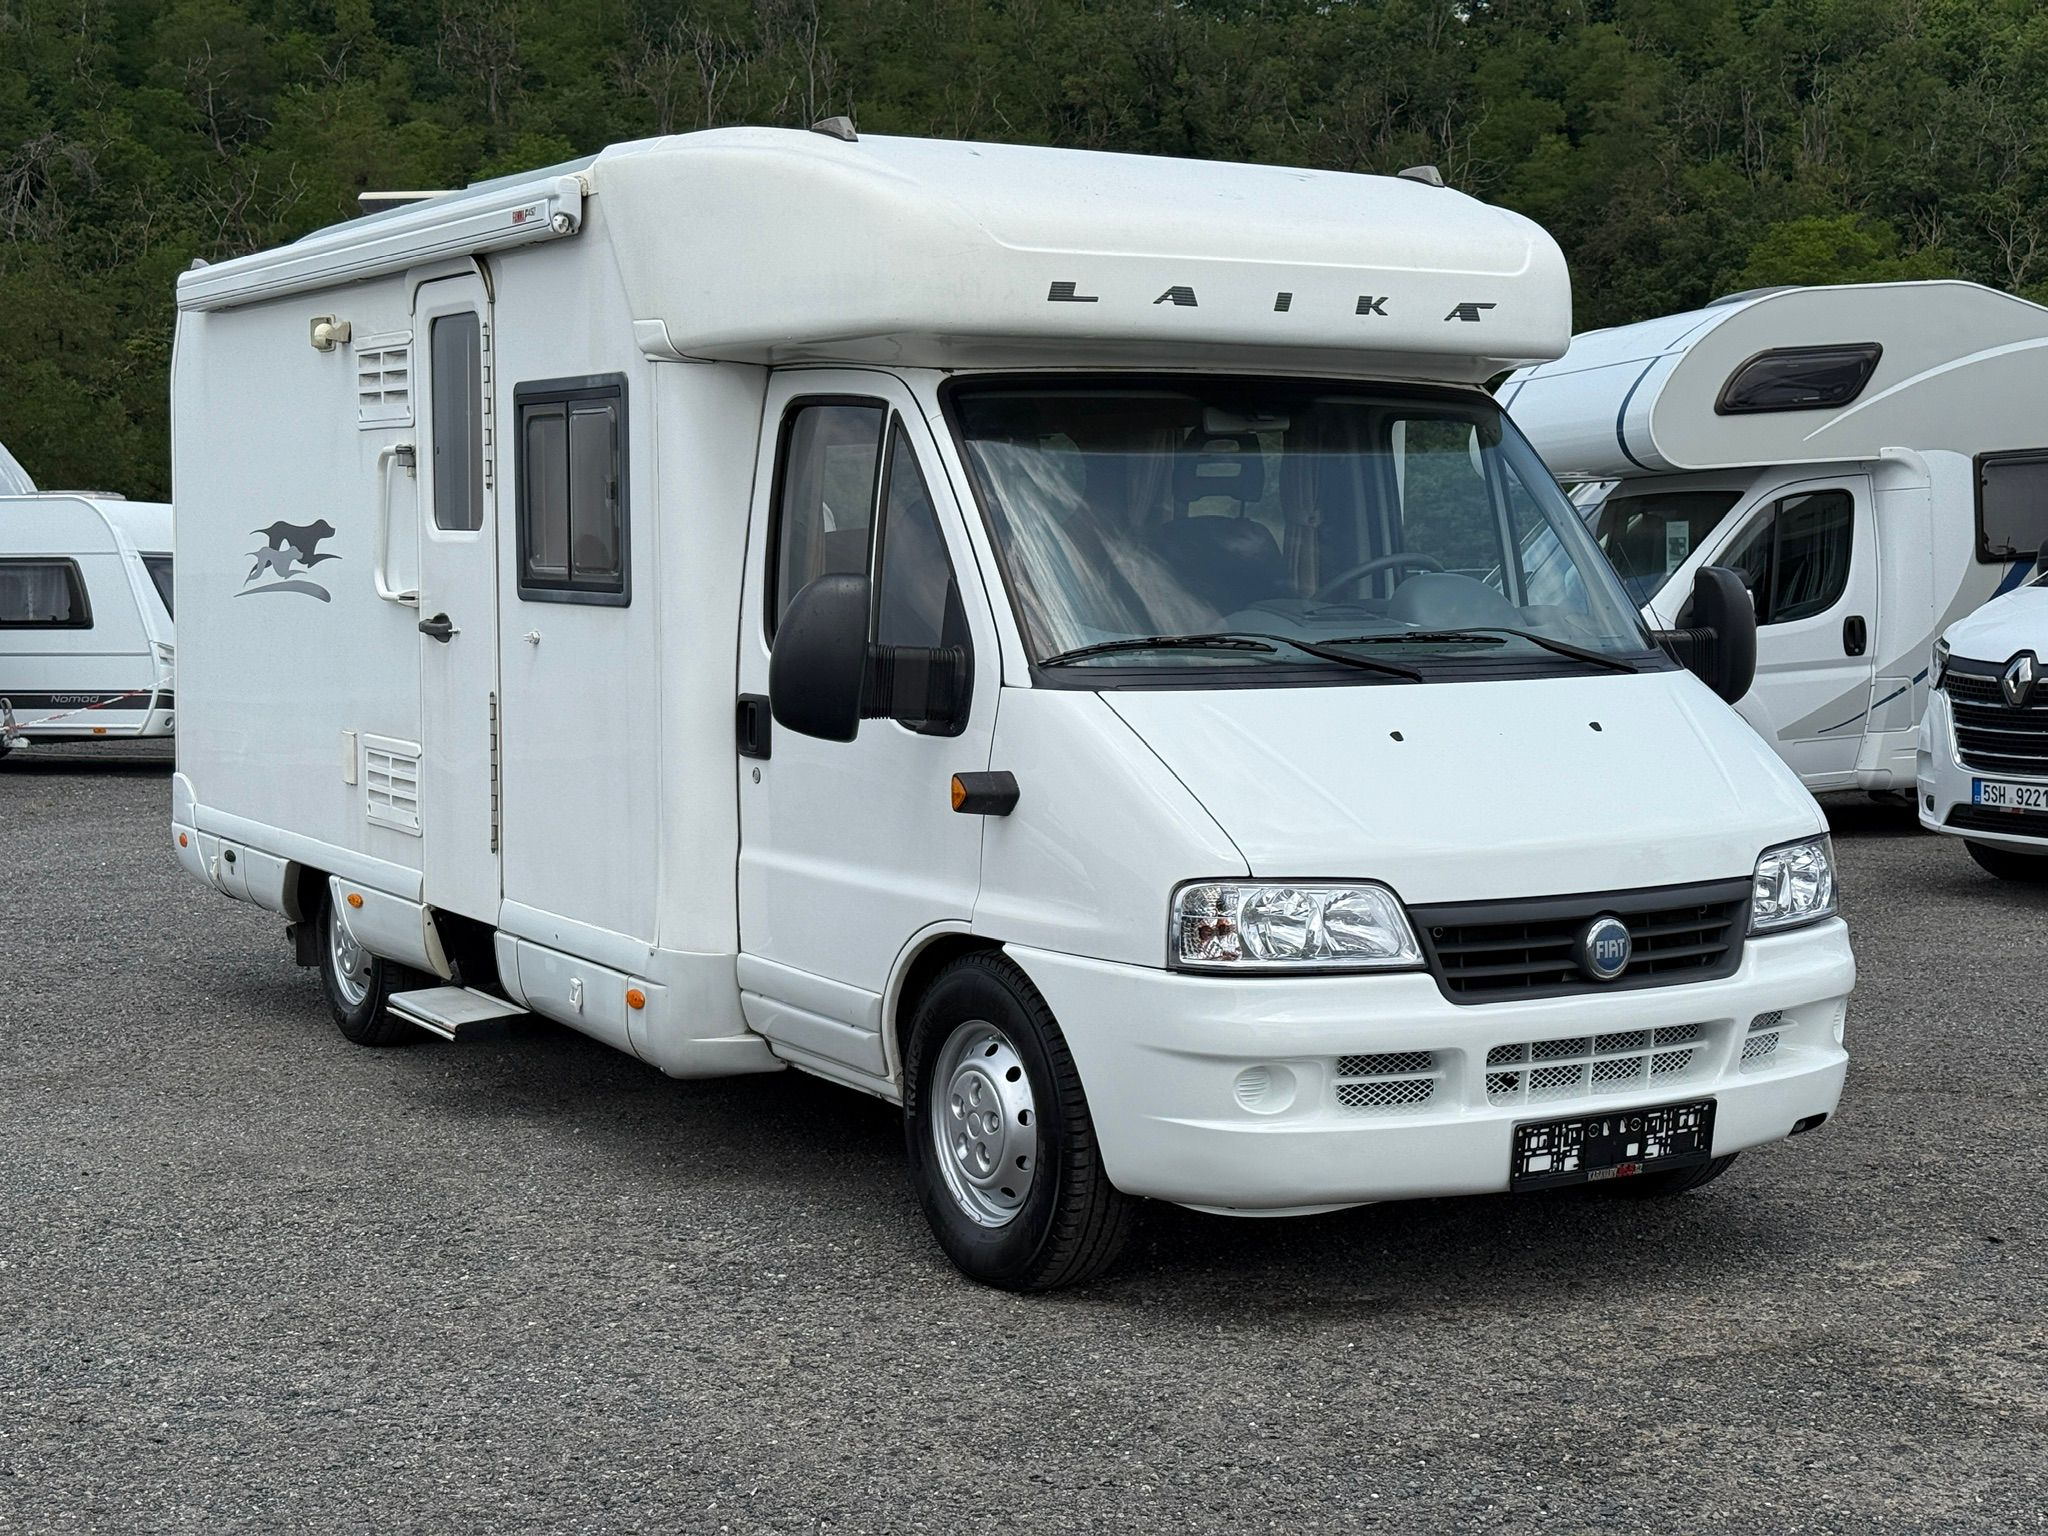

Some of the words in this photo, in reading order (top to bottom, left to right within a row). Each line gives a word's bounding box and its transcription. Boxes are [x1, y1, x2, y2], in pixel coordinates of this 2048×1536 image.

[1047, 281, 1497, 322] LAIKA
[50, 695, 100, 704] Nomad
[1983, 784, 2006, 804] 5SH
[2016, 787, 2048, 808] 9221
[1595, 938, 1625, 960] FIAT
